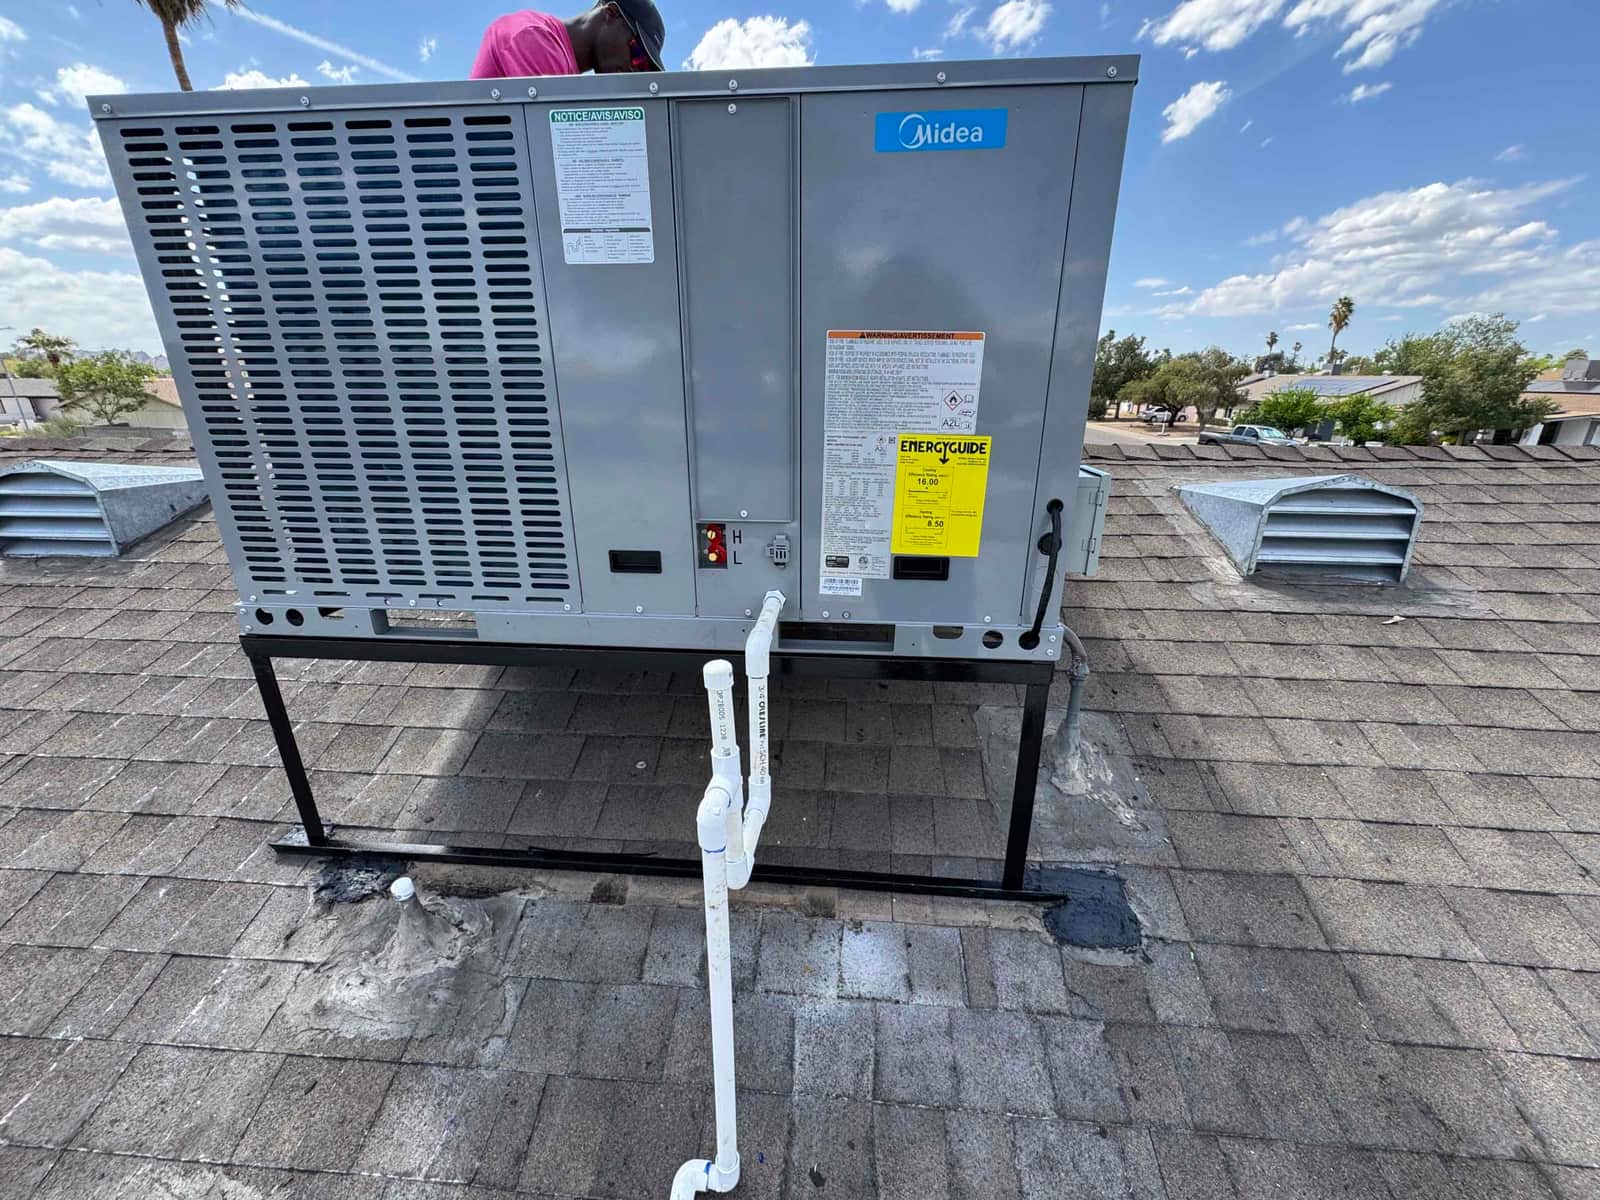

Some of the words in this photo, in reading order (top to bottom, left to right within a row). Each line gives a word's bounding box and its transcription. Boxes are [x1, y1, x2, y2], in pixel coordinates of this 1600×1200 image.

[553, 110, 642, 122] NOTICE/AVIS/AVISO
[903, 119, 984, 147] Midea
[942, 418, 960, 428] A2L
[917, 478, 940, 486] 16.00
[732, 529, 743, 545] H
[733, 550, 743, 565] L
